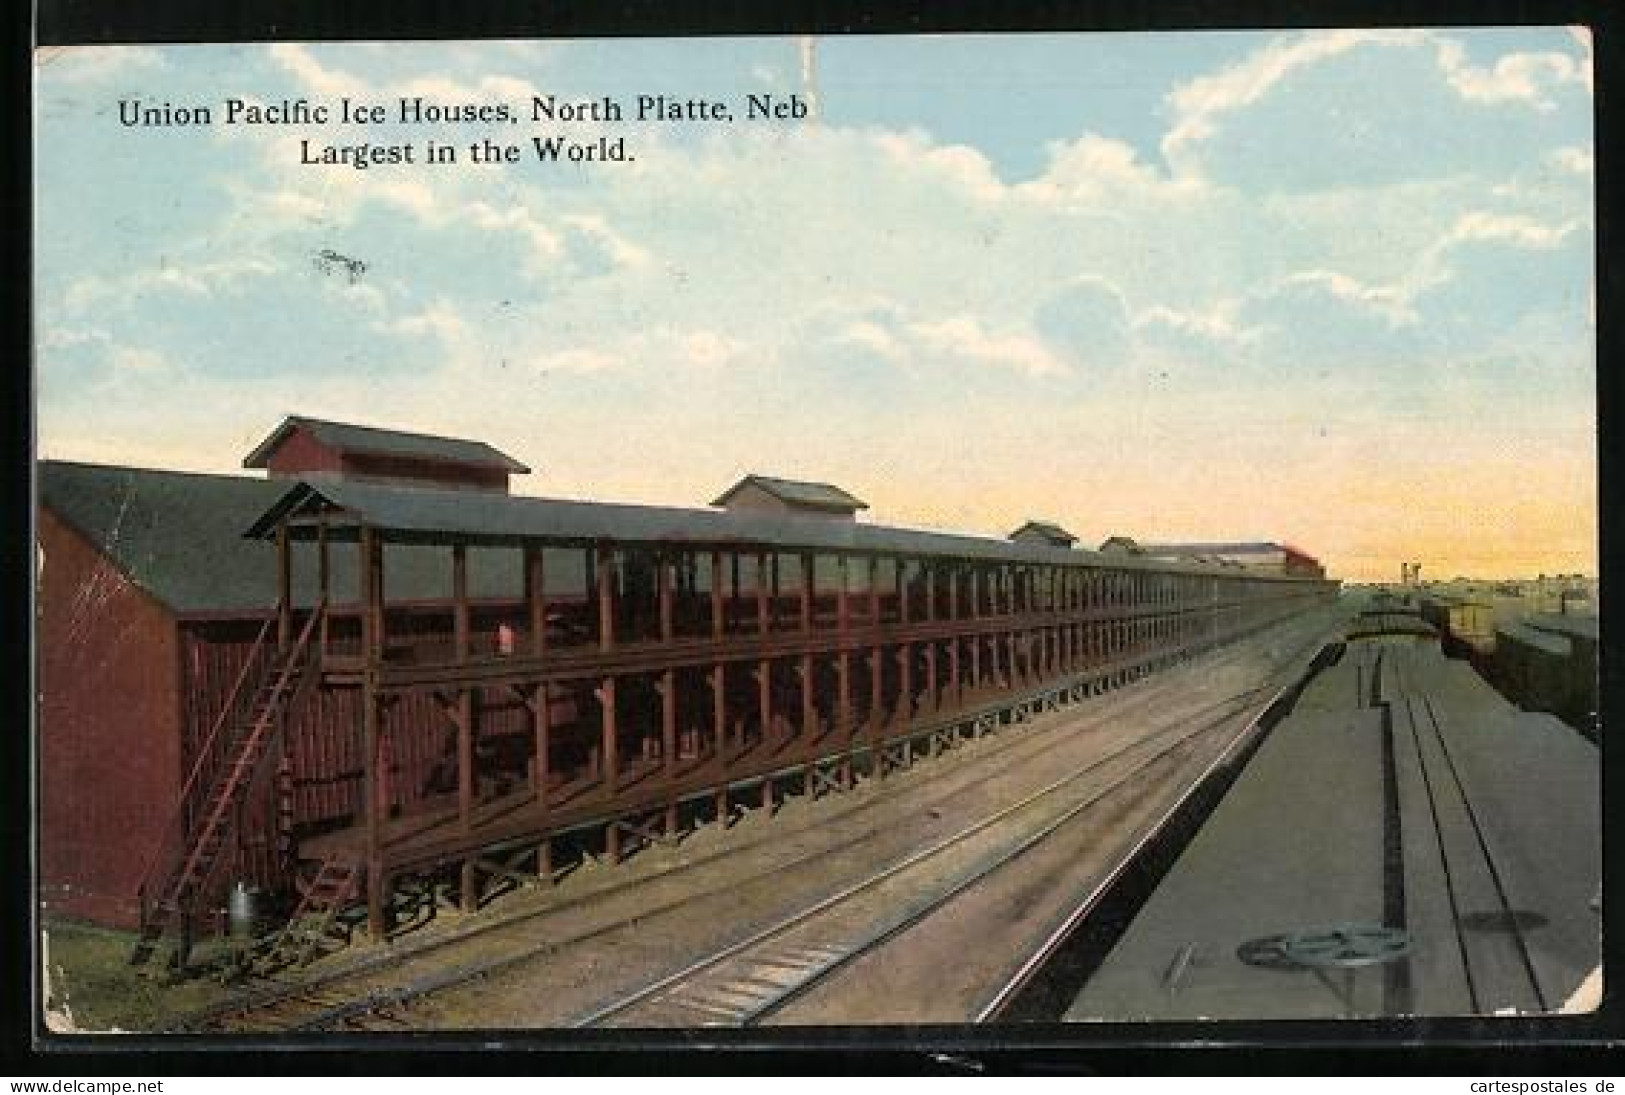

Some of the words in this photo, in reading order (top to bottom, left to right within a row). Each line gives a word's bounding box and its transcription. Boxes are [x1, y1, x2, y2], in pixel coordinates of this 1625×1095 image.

[118, 99, 212, 127] Union
[226, 98, 328, 125] Pacific
[341, 98, 387, 125] Ice
[400, 98, 519, 128] Houses,
[532, 96, 623, 123] North
[637, 95, 734, 124] Platte,
[746, 93, 809, 120] Neb
[300, 140, 414, 170] Largest
[427, 139, 457, 165] in
[470, 139, 521, 163] the
[533, 137, 636, 163] World.
